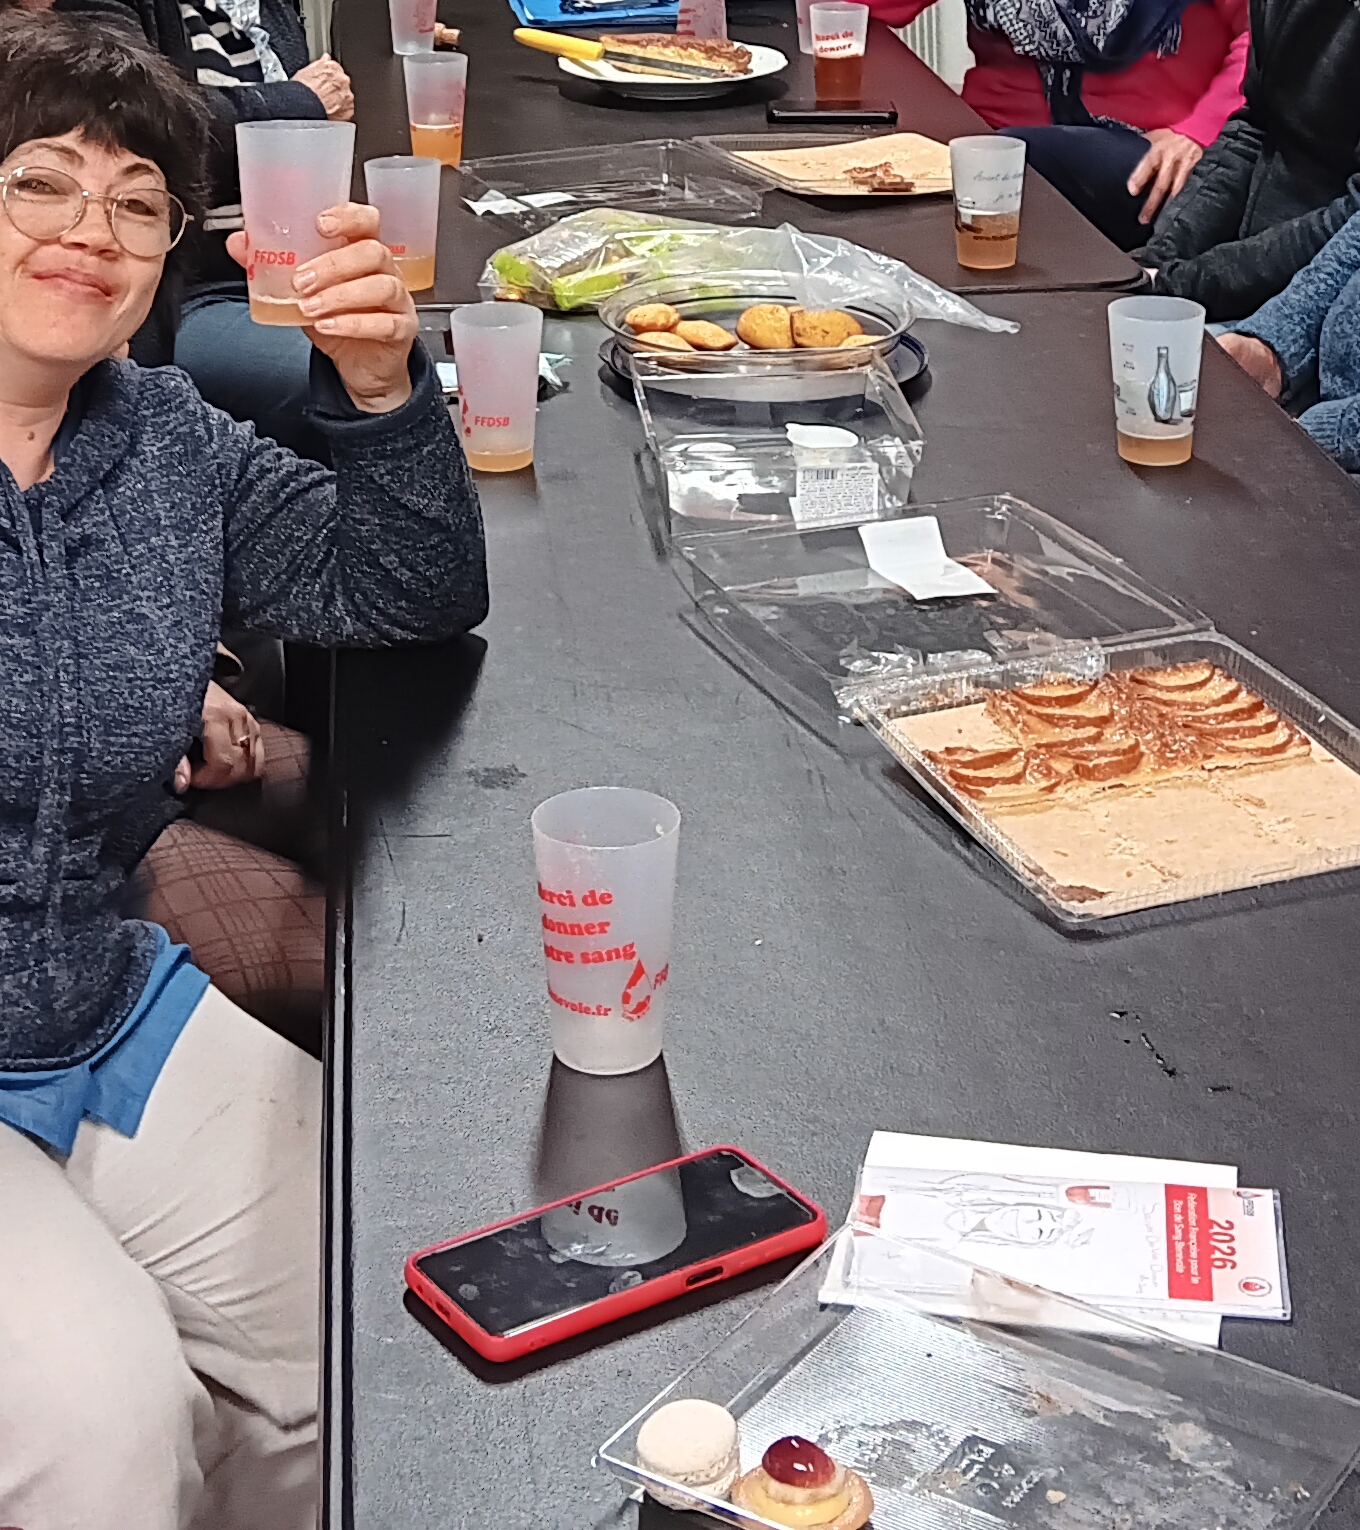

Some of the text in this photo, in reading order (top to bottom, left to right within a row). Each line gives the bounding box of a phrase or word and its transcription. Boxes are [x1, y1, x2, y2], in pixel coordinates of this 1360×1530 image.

[254, 250, 296, 265] FFDSB
[474, 416, 510, 427] FFDSB
[582, 889, 613, 907] de
[580, 942, 636, 965] sang
[1209, 1219, 1237, 1270] 2026
